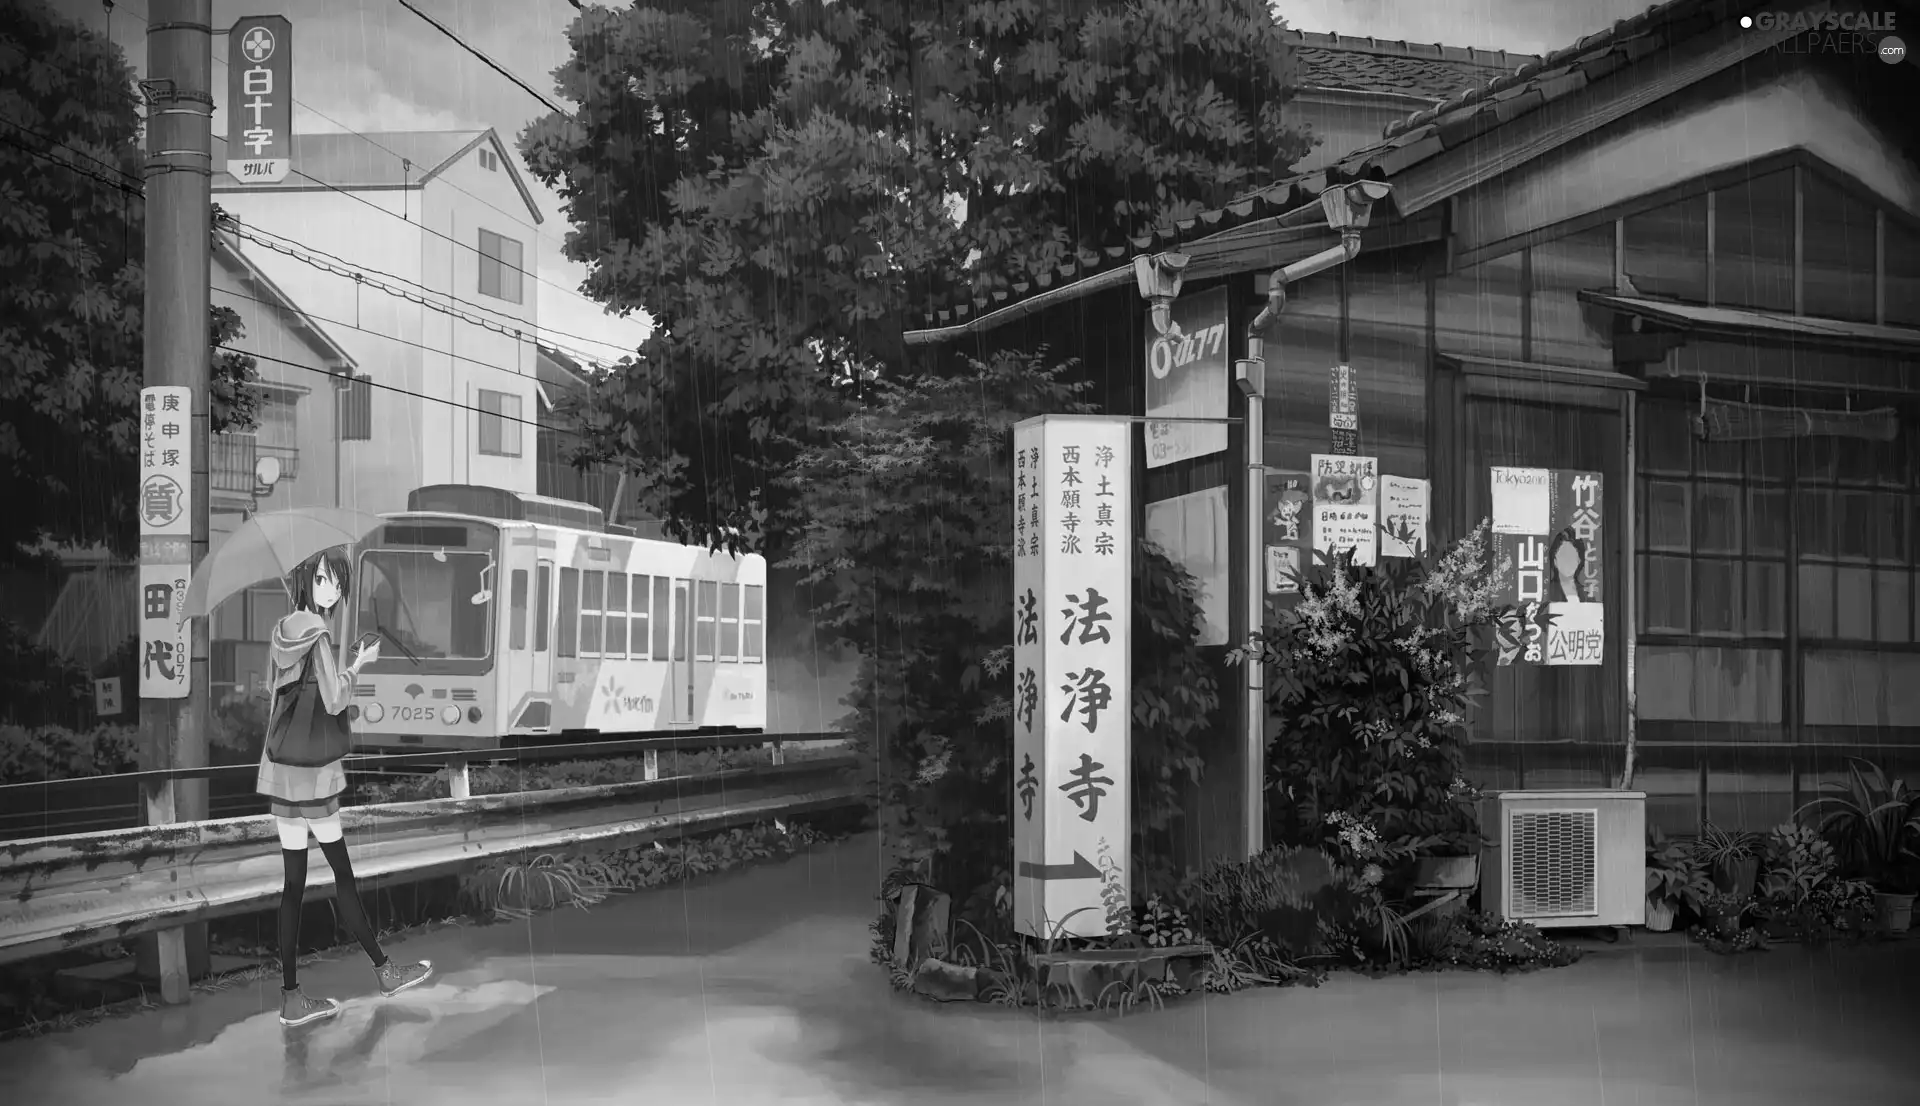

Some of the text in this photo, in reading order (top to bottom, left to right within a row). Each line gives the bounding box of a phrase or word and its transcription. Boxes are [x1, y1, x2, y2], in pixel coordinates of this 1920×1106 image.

[243, 65, 272, 156] 白十字
[144, 393, 156, 468] 電停そば
[161, 393, 181, 467] 庚申塚
[143, 482, 176, 522] 質
[1030, 446, 1040, 556] 浄土真宗
[1060, 444, 1083, 555] 西本願寺派
[1094, 445, 1116, 556] 浄土真宗
[1571, 475, 1600, 598] 竹谷とし子
[143, 582, 176, 681] 田代
[1549, 629, 1601, 661] 公明党
[391, 705, 435, 721] 7025
[1016, 587, 1039, 822] 法浄寺
[1058, 587, 1115, 823] 法浄寺
